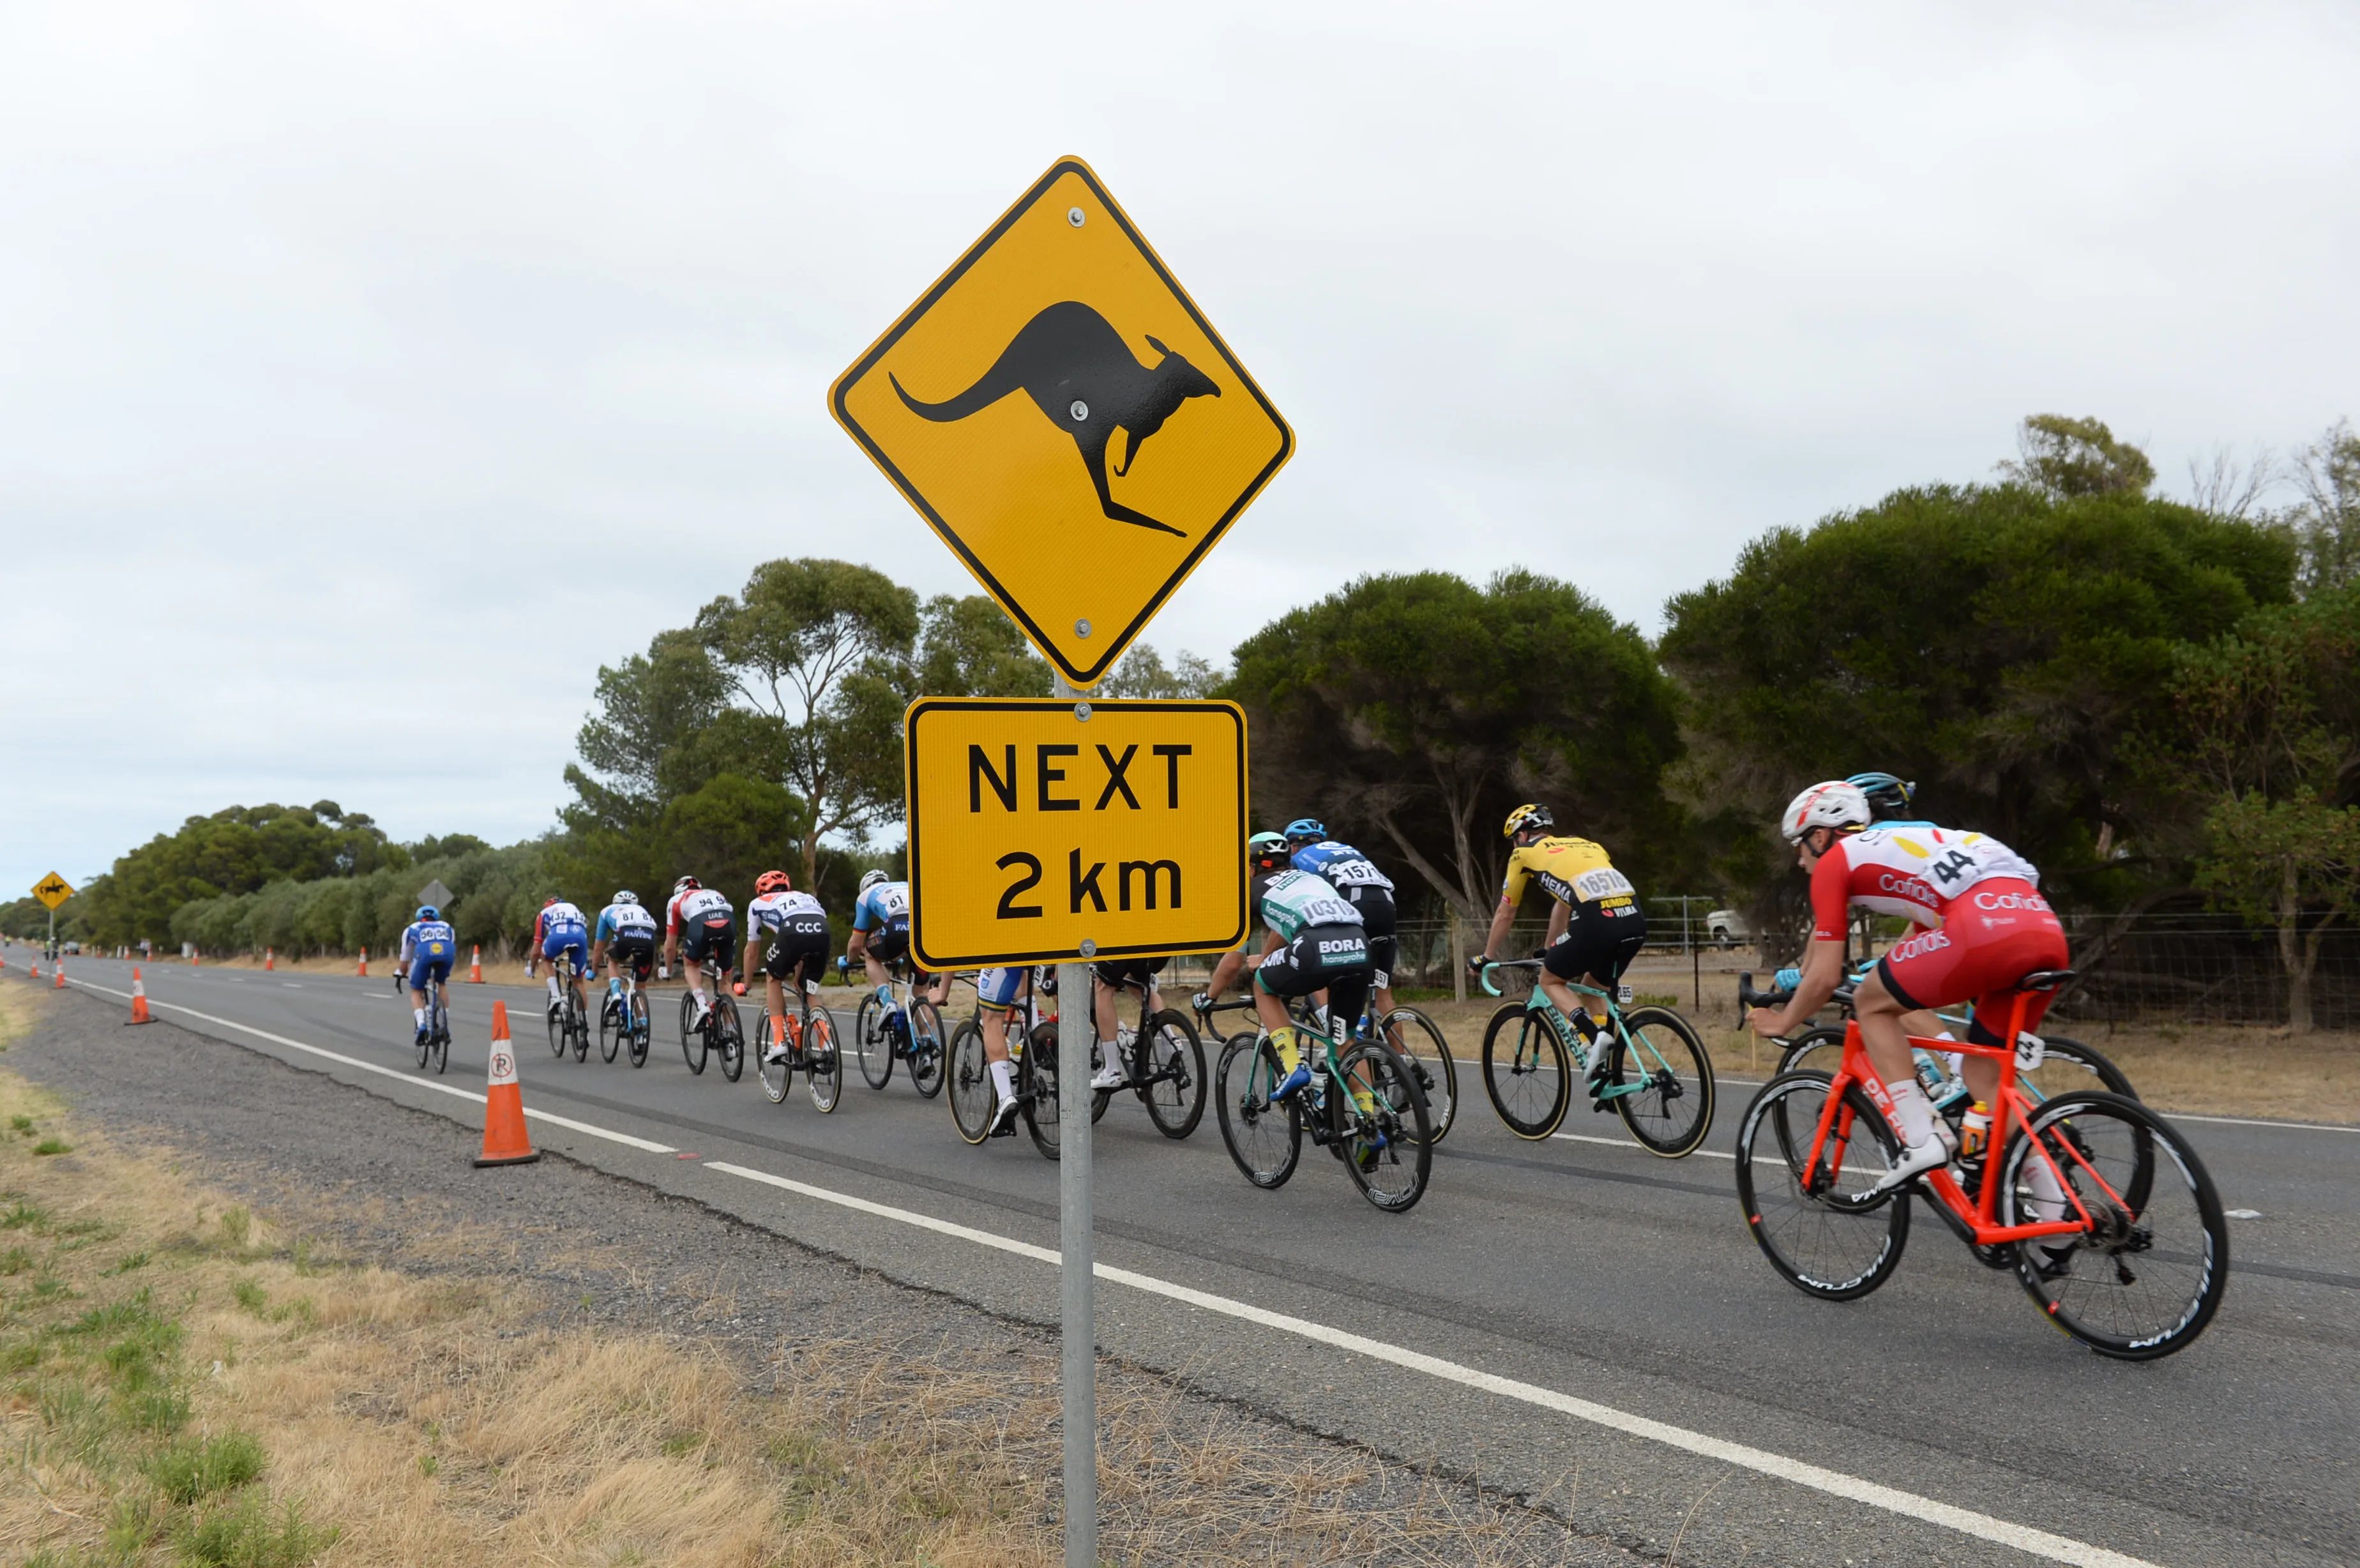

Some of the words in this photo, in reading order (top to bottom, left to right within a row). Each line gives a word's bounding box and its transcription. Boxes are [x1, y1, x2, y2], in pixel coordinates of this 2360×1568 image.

[968, 744, 1192, 813] NEXT
[1343, 865, 1372, 879] 157
[1932, 850, 1977, 884] 44
[995, 851, 1043, 920] 2
[1069, 847, 1182, 914] km
[1541, 872, 1571, 904] HEMA
[1579, 872, 1610, 894] 165
[779, 898, 798, 910] 74
[1600, 896, 1632, 909] JUMBO
[796, 921, 822, 933] CCC
[766, 942, 780, 962] CCC
[1319, 938, 1366, 954] BORA
[1322, 952, 1366, 964] hansgrohe
[1619, 986, 1631, 999] 165
